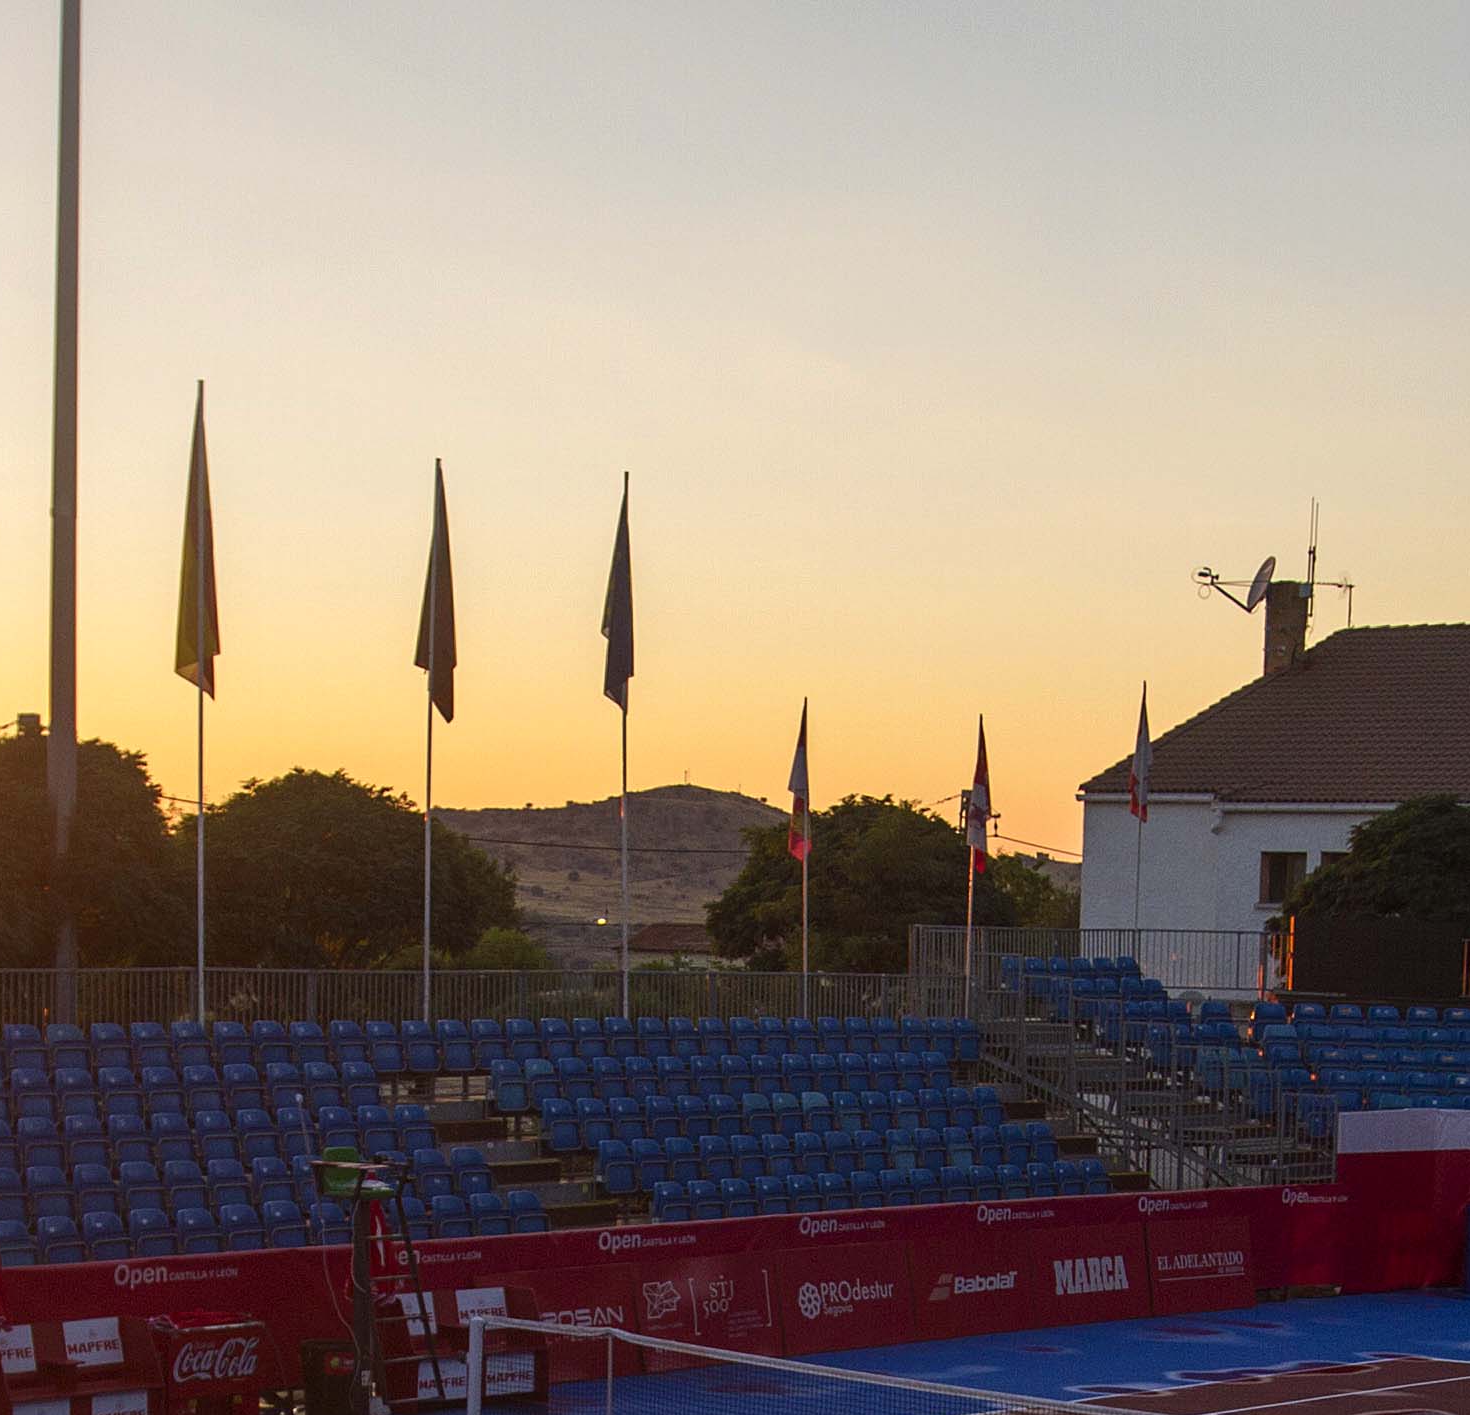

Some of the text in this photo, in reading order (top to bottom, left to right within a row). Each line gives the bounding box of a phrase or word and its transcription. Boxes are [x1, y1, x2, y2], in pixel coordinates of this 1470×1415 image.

[977, 1204, 1011, 1225] Open
[1137, 1196, 1170, 1216] Open
[799, 1216, 838, 1237] Open
[598, 1231, 641, 1254] Open
[1157, 1255, 1172, 1271] EL
[1173, 1250, 1244, 1270] ADELANTADO
[114, 1264, 168, 1290] Open
[169, 1269, 207, 1281] CASTILLA
[1053, 1255, 1129, 1295] MARCA
[820, 1277, 894, 1303] PROdestur
[702, 1298, 729, 1319] 500
[67, 1338, 120, 1355] MAPFRE
[418, 1375, 466, 1390] MAFRE
